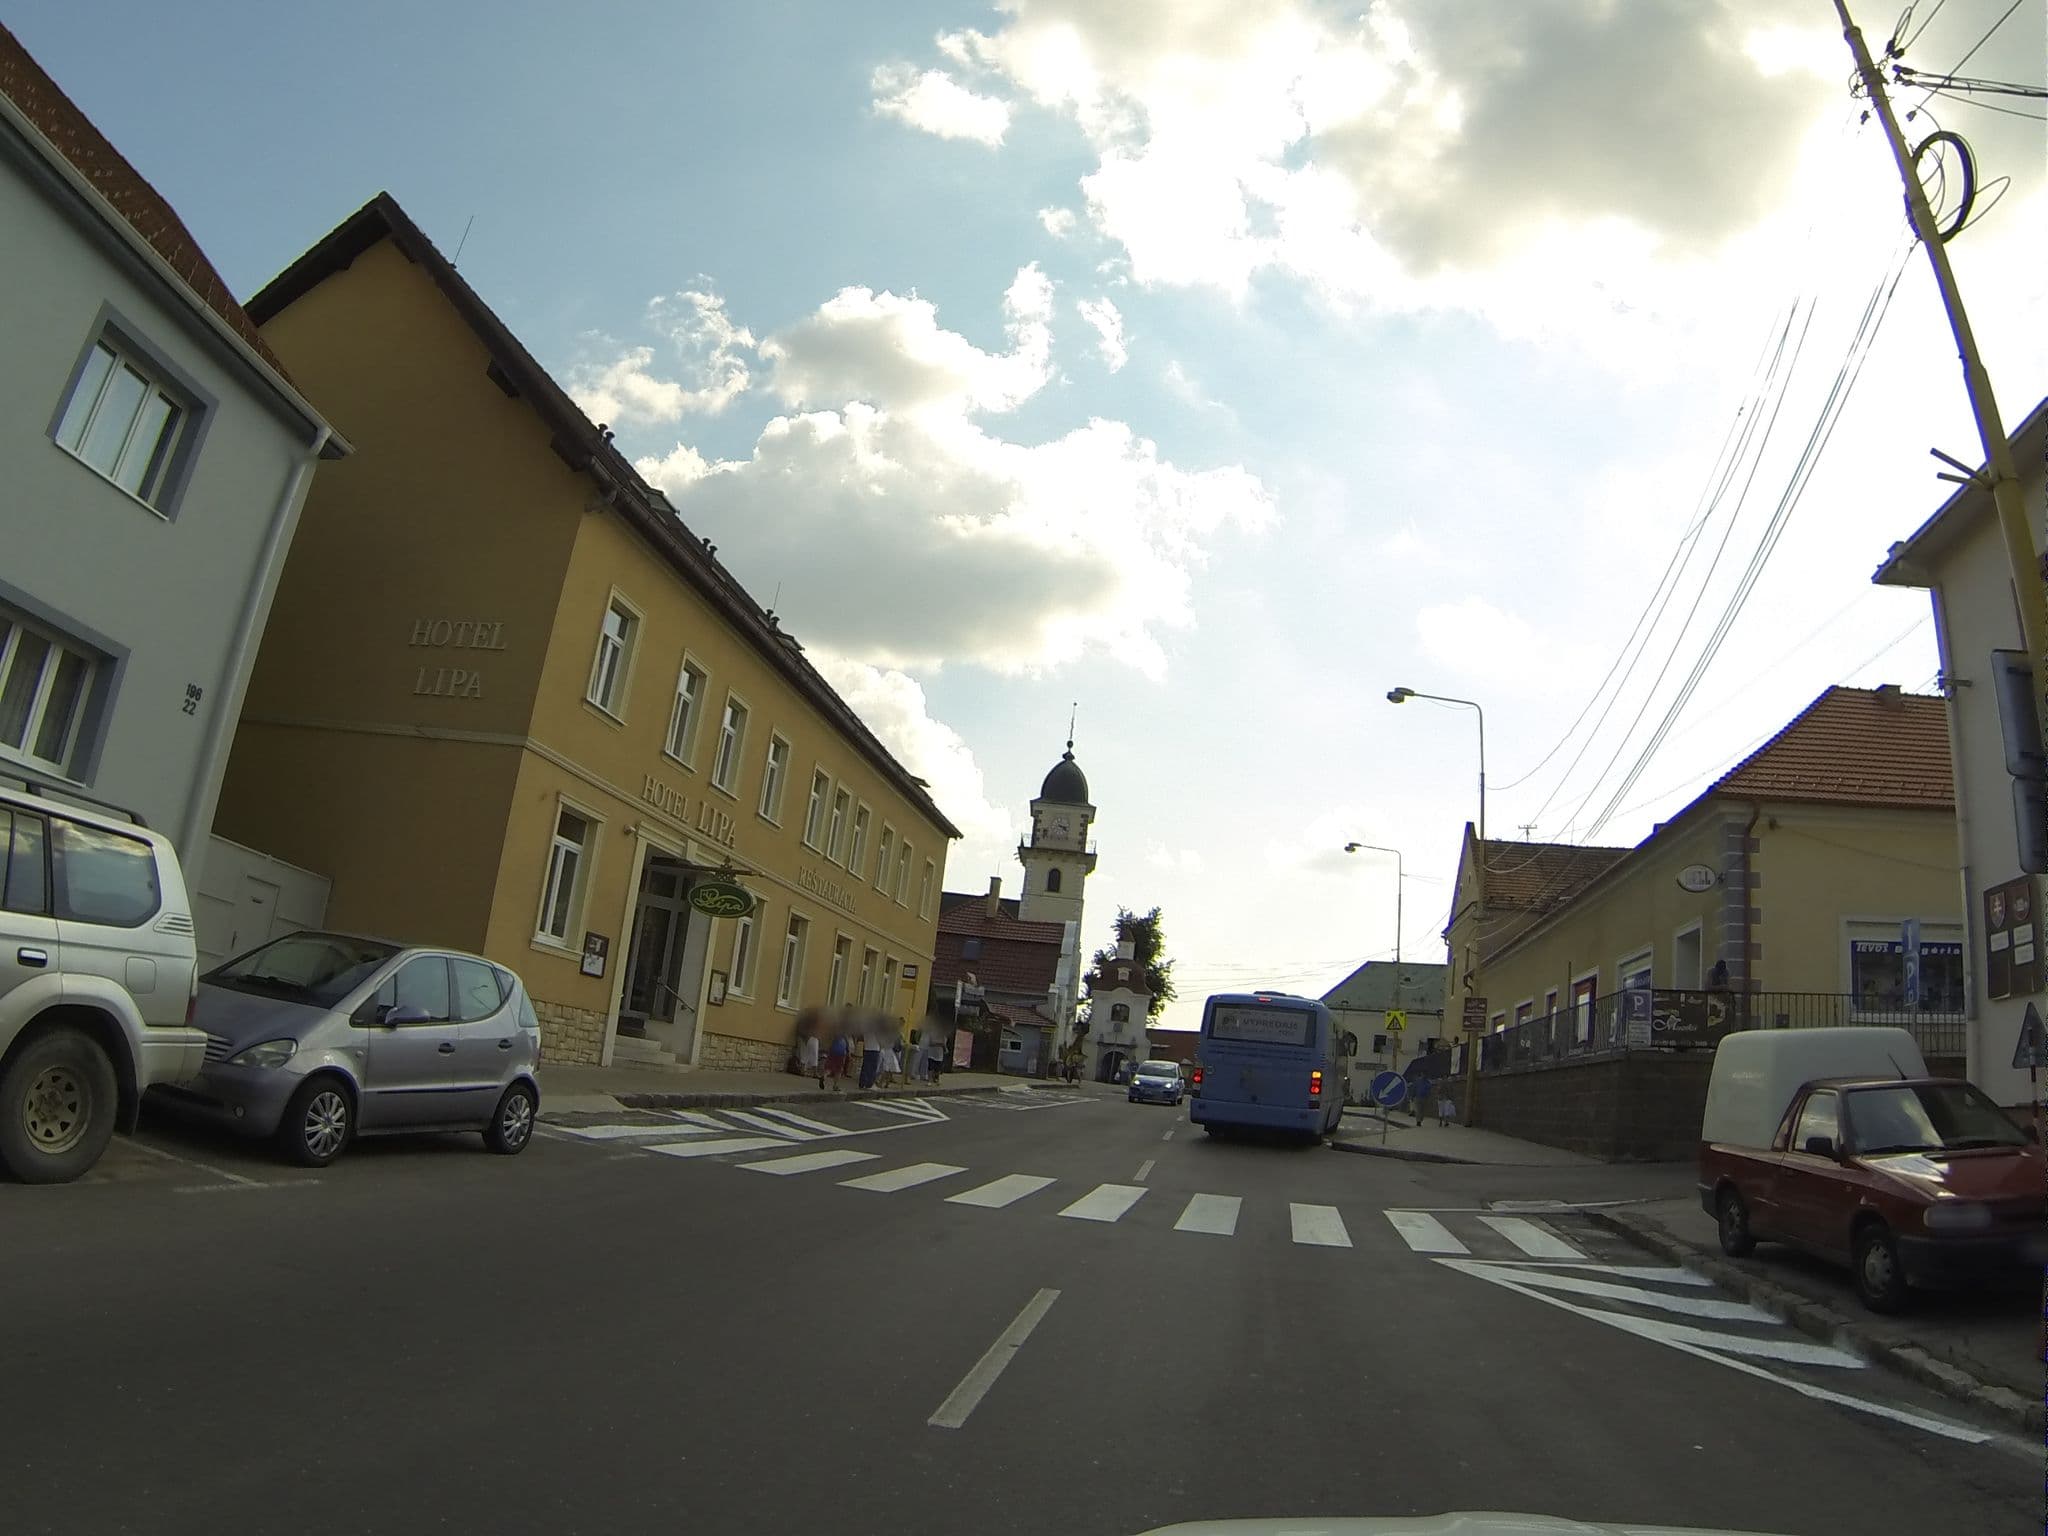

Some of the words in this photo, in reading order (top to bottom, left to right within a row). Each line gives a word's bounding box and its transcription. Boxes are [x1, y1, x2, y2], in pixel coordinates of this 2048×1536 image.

[408, 617, 508, 651] HOTEL
[412, 666, 483, 699] LIPA
[182, 698, 197, 716] 22
[641, 774, 690, 824] HOTEL
[696, 800, 737, 849] LIPA
